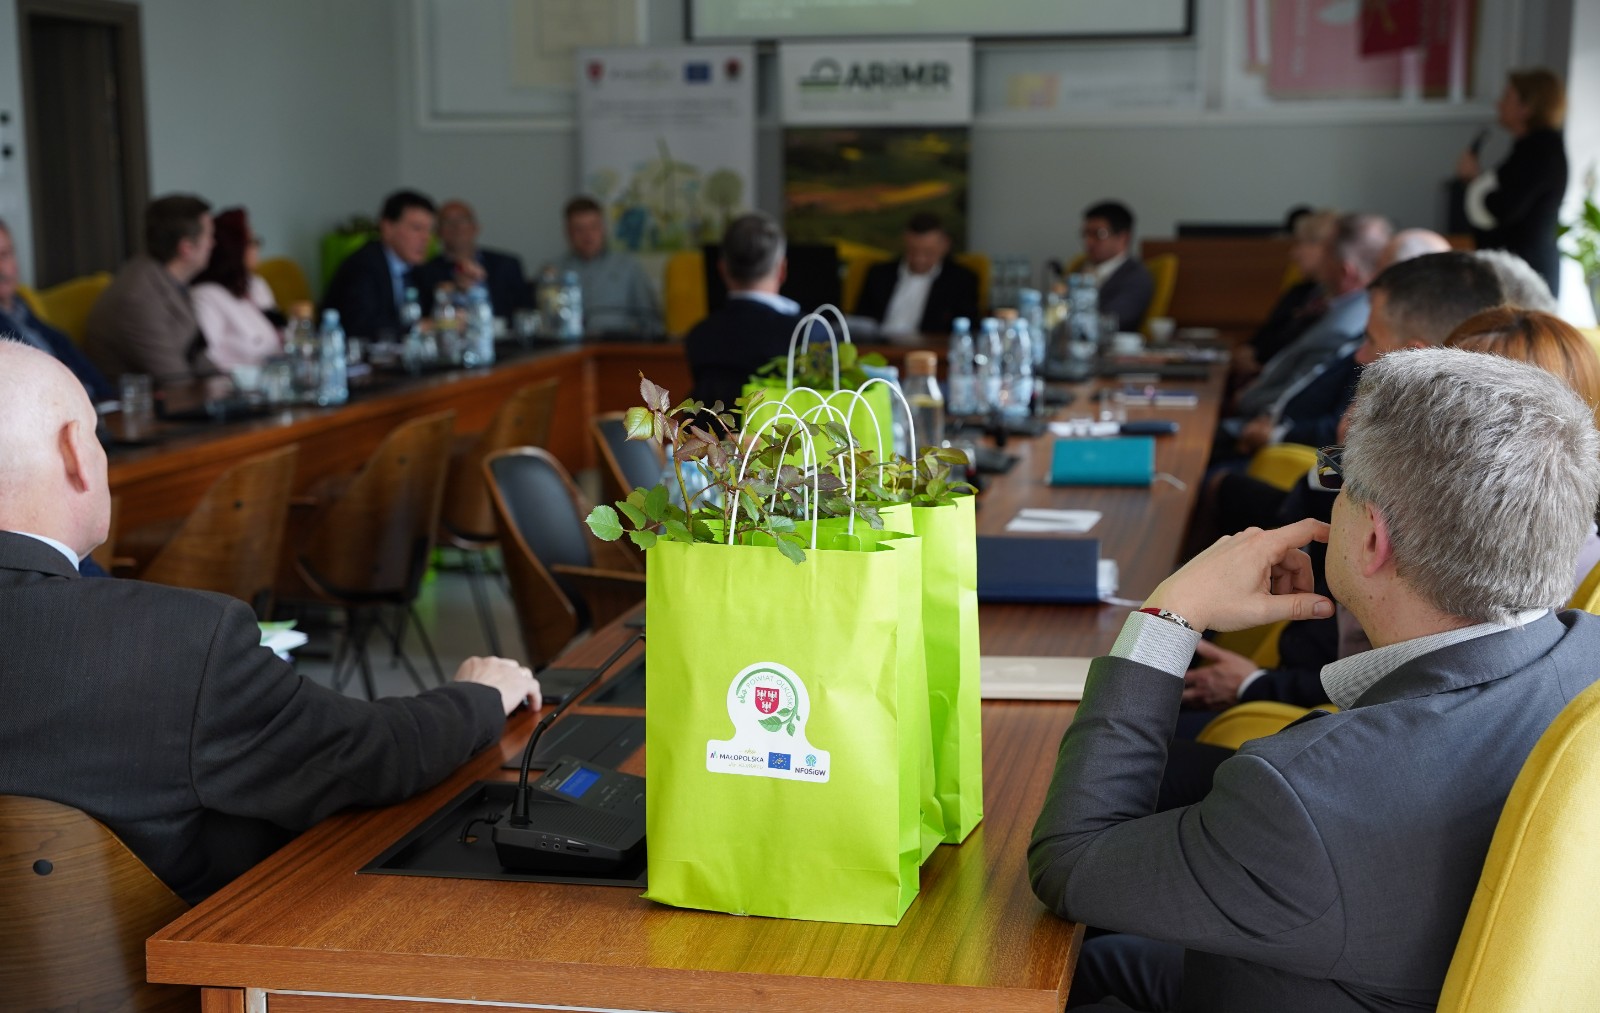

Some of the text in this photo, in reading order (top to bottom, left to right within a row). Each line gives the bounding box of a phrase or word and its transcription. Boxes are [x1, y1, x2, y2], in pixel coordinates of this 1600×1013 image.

[747, 675, 774, 689] POWIAT
[776, 679, 794, 709] OLKUSKI
[719, 753, 764, 763] MAŁOPOLSKA
